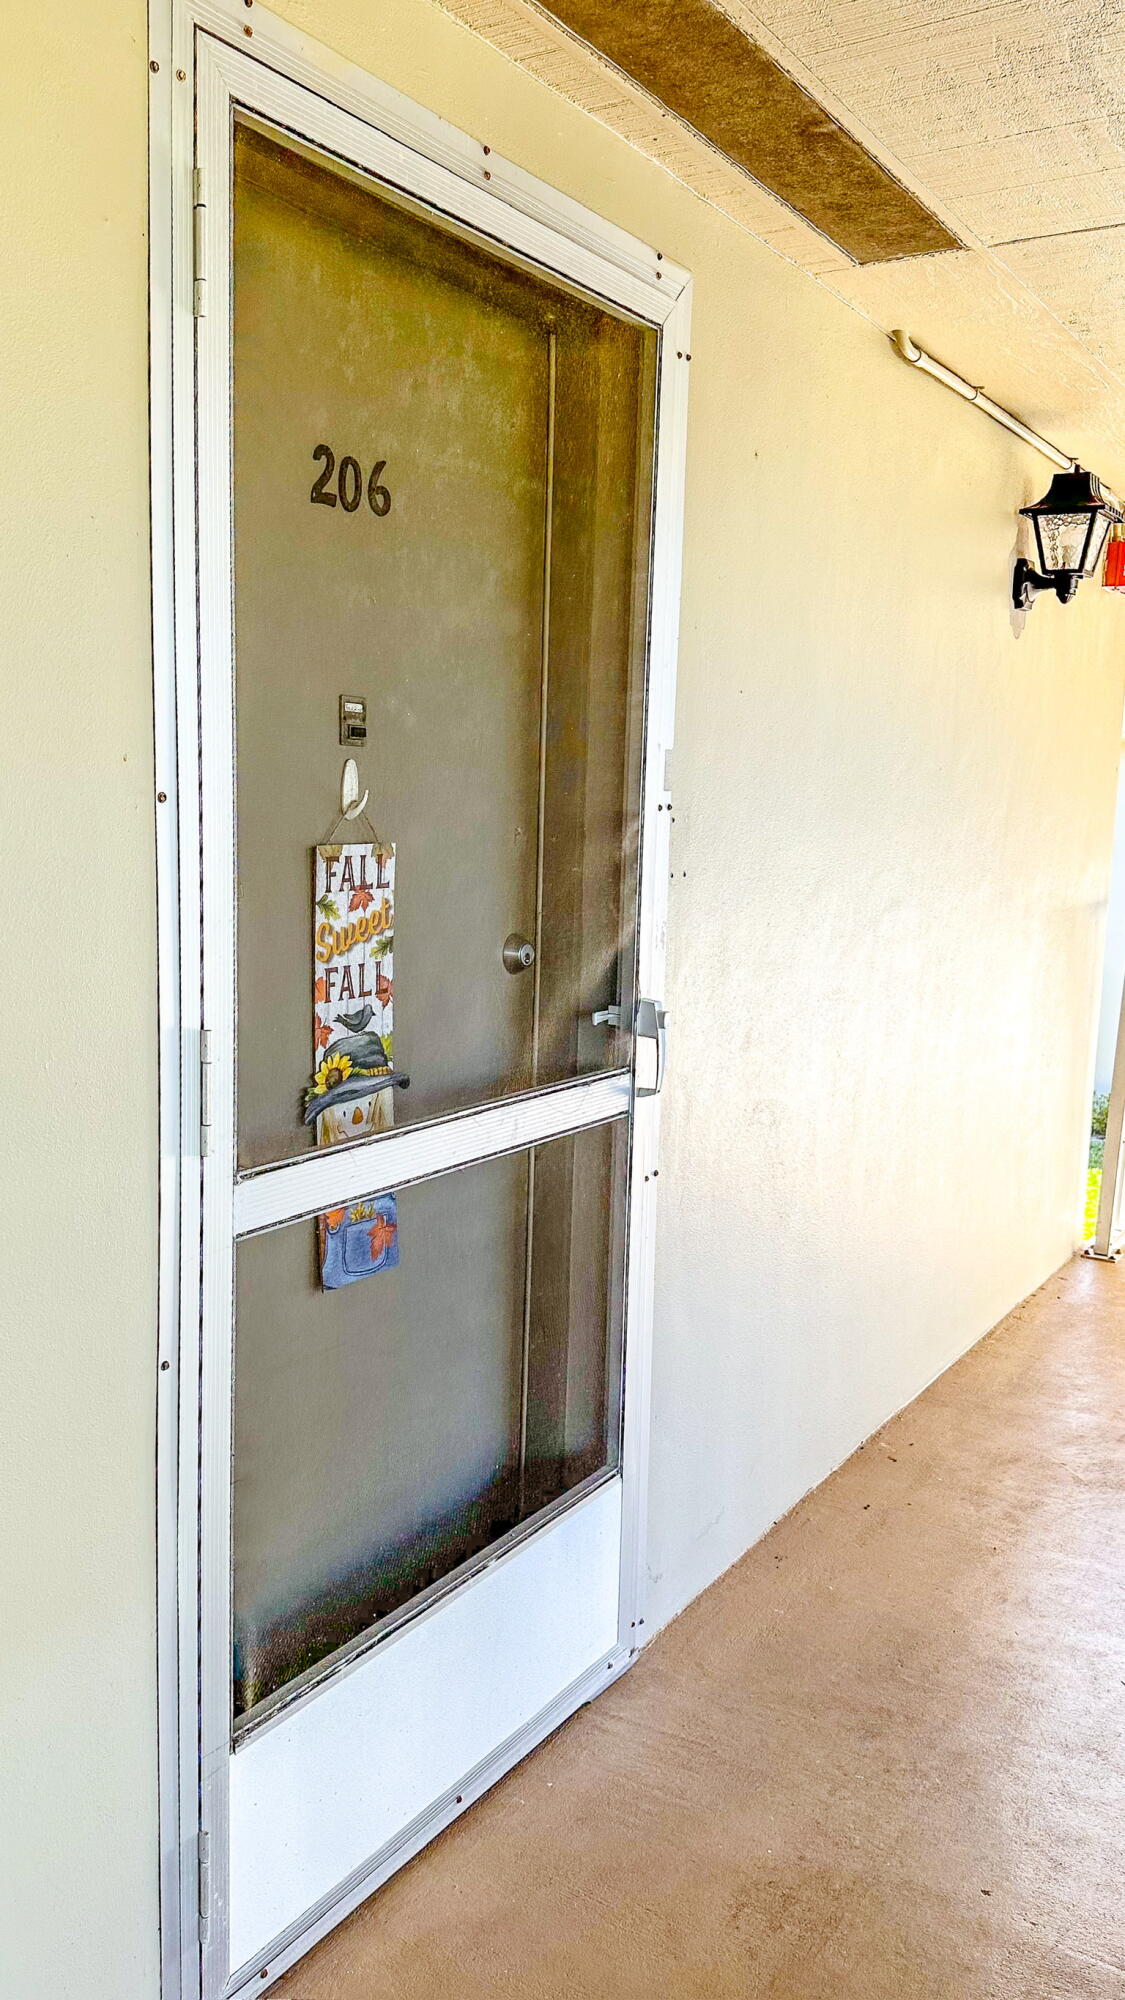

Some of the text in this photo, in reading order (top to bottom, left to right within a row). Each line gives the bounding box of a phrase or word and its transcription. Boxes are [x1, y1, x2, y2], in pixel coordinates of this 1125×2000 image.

[310, 444, 391, 517] 206
[325, 853, 389, 893] FALL
[315, 896, 393, 963] Sweet
[324, 960, 389, 1003] FALL
